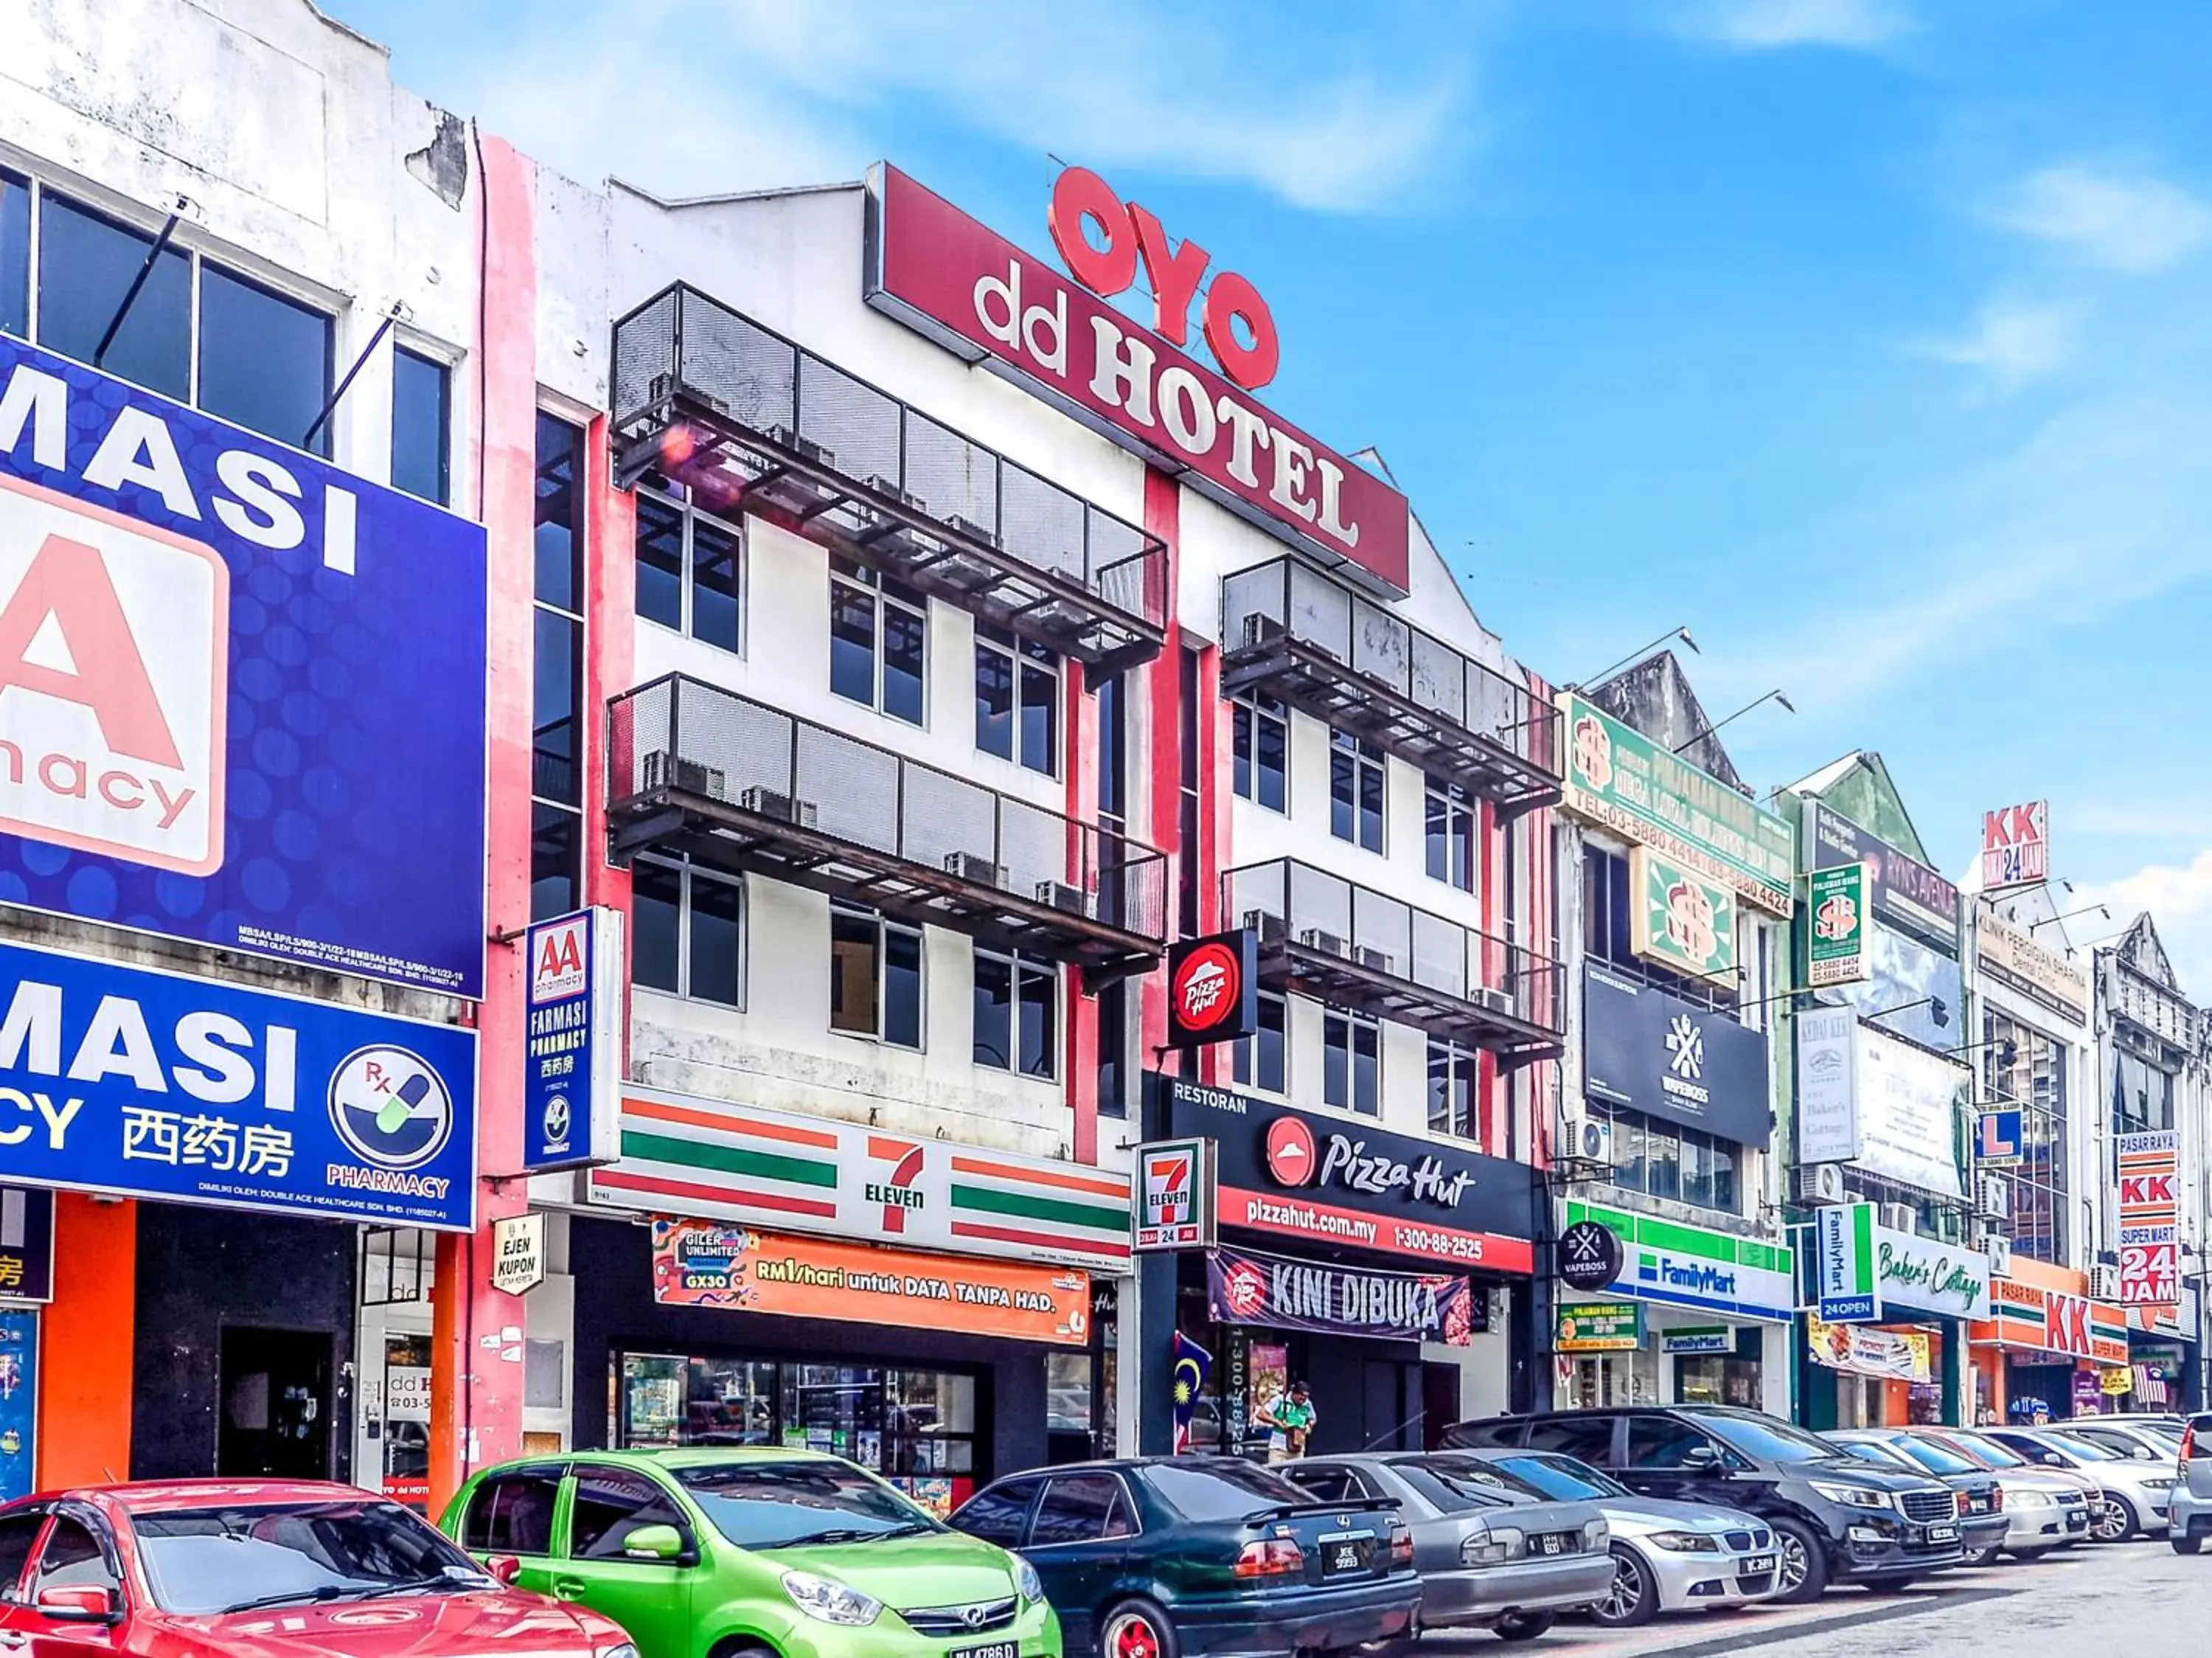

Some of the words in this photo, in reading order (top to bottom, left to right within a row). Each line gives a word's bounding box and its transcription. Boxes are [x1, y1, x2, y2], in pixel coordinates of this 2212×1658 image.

[1048, 166, 1279, 390] OYO
[973, 260, 1067, 377] dd
[1089, 315, 1360, 548] HOTEL
[1986, 802, 2039, 848] KK
[2004, 846, 2020, 881] 24
[324, 952, 340, 962] ACE
[538, 929, 582, 981] AA
[1185, 977, 1225, 1010] Pizza
[1192, 991, 1221, 1016] Hut
[531, 999, 587, 1036] FARMASI
[530, 1027, 587, 1058] PHARMACY
[1174, 1083, 1247, 1114] RESTORAN
[122, 1106, 295, 1177] 西药房
[327, 1163, 450, 1199] PHARMACY
[868, 1135, 923, 1233] 7
[1321, 1133, 1410, 1193] Pizza
[1411, 1155, 1475, 1207] Hut
[260, 1189, 294, 1201] DOUBLE
[295, 1193, 312, 1204] ACE
[313, 1196, 365, 1210] HEALTHCARE
[1152, 1159, 1187, 1224] 7
[2121, 1175, 2173, 1204] KK
[503, 1236, 531, 1256] EJEN
[685, 1233, 722, 1246] GILER
[1161, 1229, 1175, 1244] 24
[1247, 1198, 1377, 1241] pizzahut.com.my
[1394, 1229, 1483, 1260] 1-300-88-2525
[498, 1256, 536, 1277] KUPON
[685, 1245, 740, 1257] UNLIMITED
[1565, 1260, 1607, 1273] VAPEBOSS
[1829, 1210, 1845, 1292] FamilyMart
[2122, 1246, 2175, 1281] 24
[686, 1274, 727, 1288] GX30
[757, 1257, 844, 1288] RM1/hari
[848, 1272, 902, 1295] untuk
[903, 1275, 951, 1300] DATA
[954, 1283, 1012, 1308] TANPA
[1013, 1291, 1057, 1314] HAD.
[1661, 1258, 1736, 1294] FamilyMart
[1879, 1241, 1930, 1286] Baker's
[1932, 1256, 1982, 1311] Cottage
[2123, 1280, 2174, 1302] JAM
[1273, 1263, 1332, 1319] KINI
[1341, 1274, 1440, 1330] DIBUKA
[2046, 1291, 2090, 1355] KK
[1667, 1336, 1723, 1350] FamilyMart
[391, 1376, 417, 1392] dd
